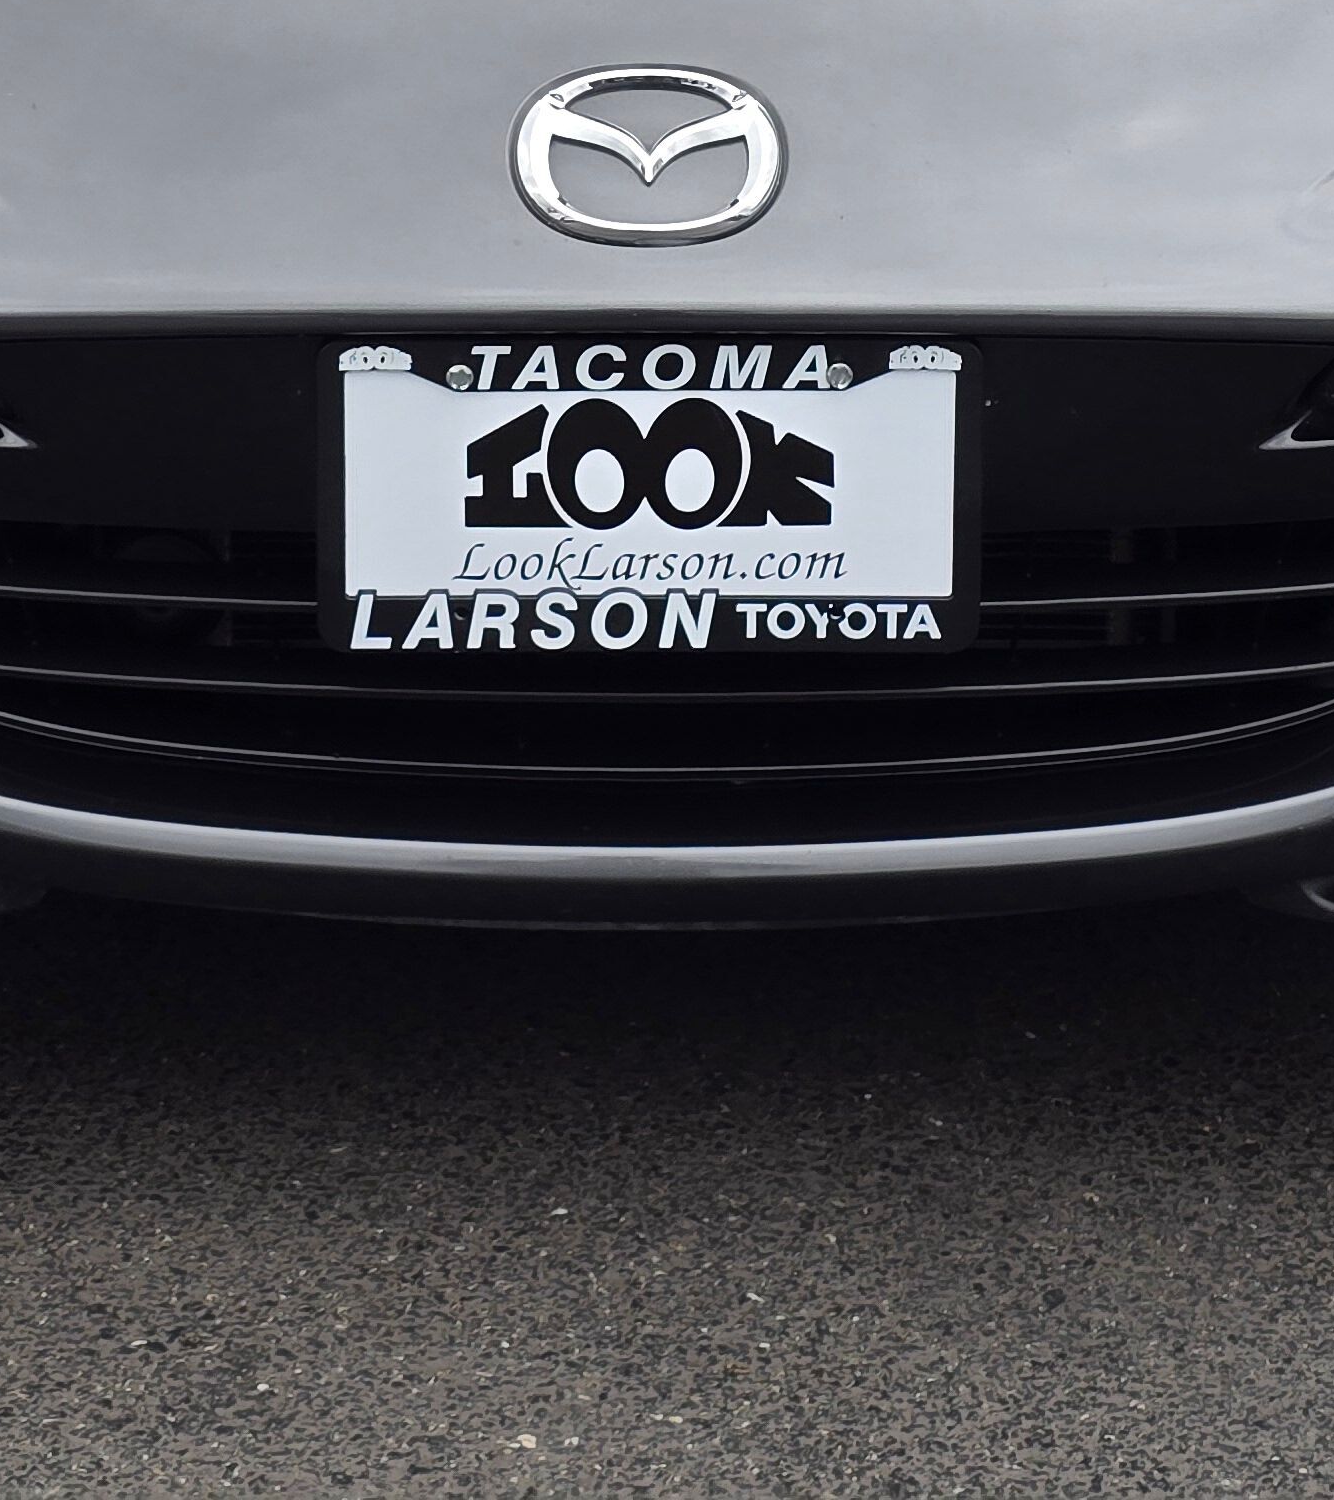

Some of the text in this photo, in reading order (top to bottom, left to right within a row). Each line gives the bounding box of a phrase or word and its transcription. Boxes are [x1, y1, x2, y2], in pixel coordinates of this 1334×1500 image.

[470, 343, 831, 391] TACOMA
[463, 396, 836, 531] LOOK
[452, 537, 848, 590] LookLarson.com
[350, 590, 942, 651] LARSON TOYOTA
